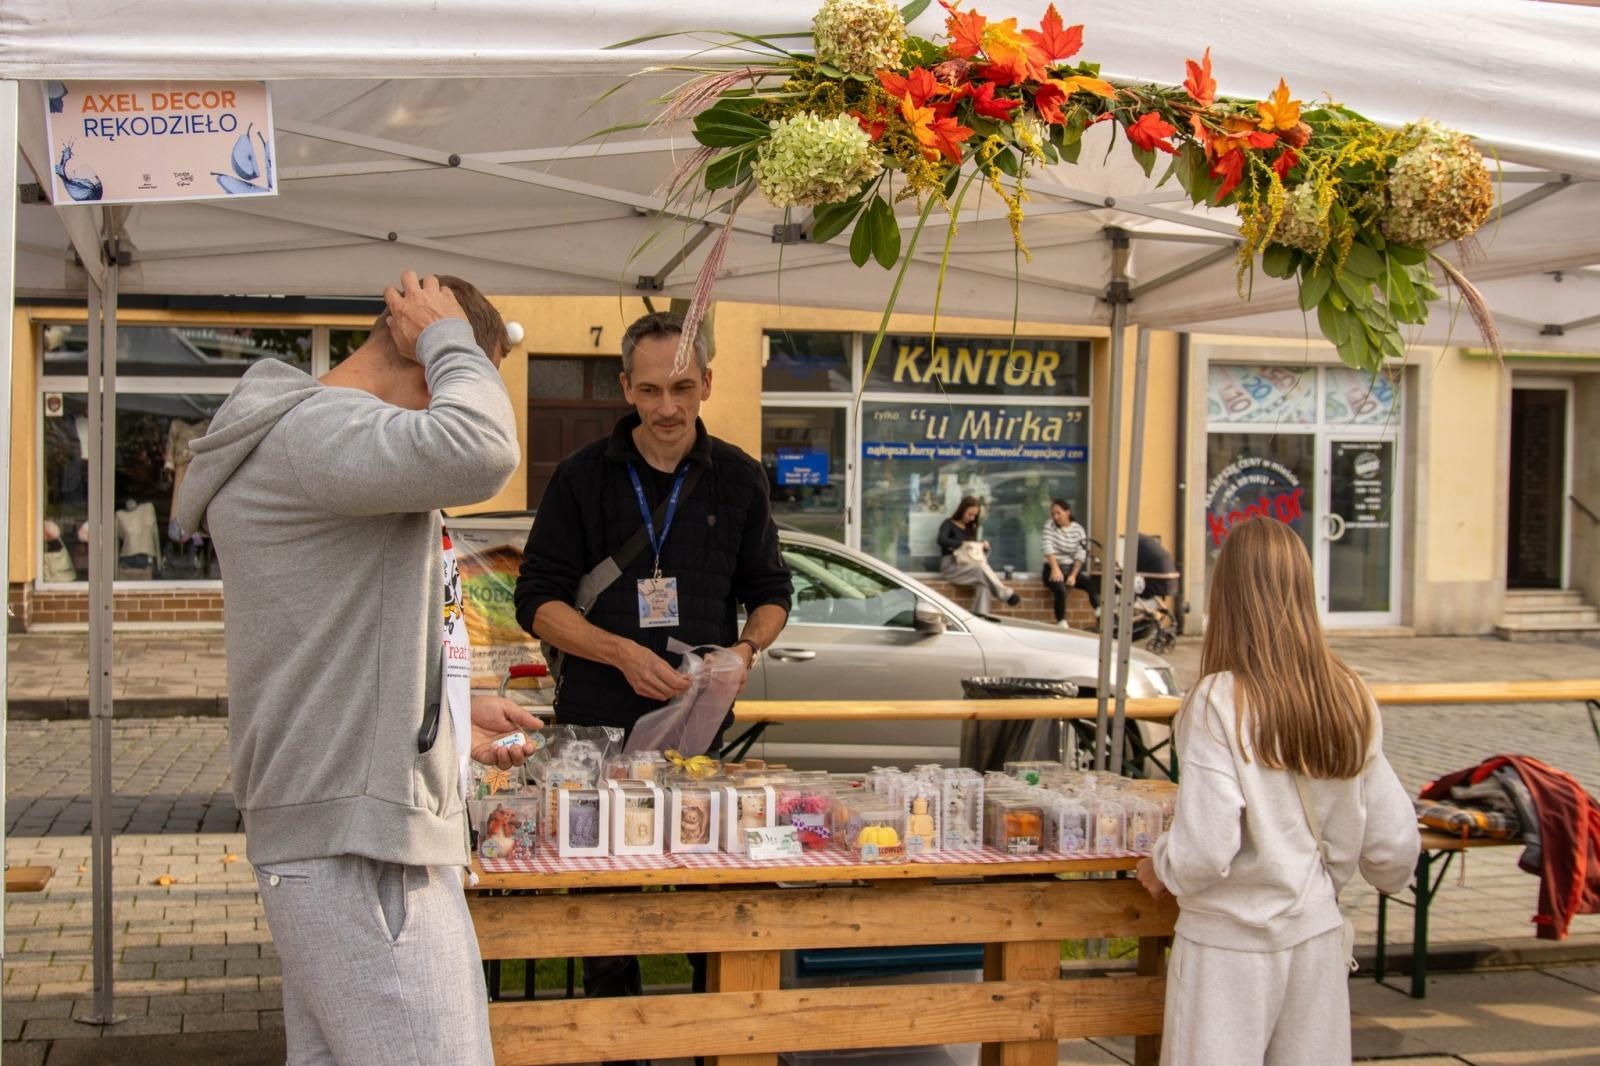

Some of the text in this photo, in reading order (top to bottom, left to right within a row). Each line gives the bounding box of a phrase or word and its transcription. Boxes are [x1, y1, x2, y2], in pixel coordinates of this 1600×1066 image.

[81, 90, 237, 113] AXEL DECOR
[84, 113, 237, 141] RĘKODZIEŁO
[590, 327, 603, 347] 7
[893, 345, 1060, 387] KANTOR
